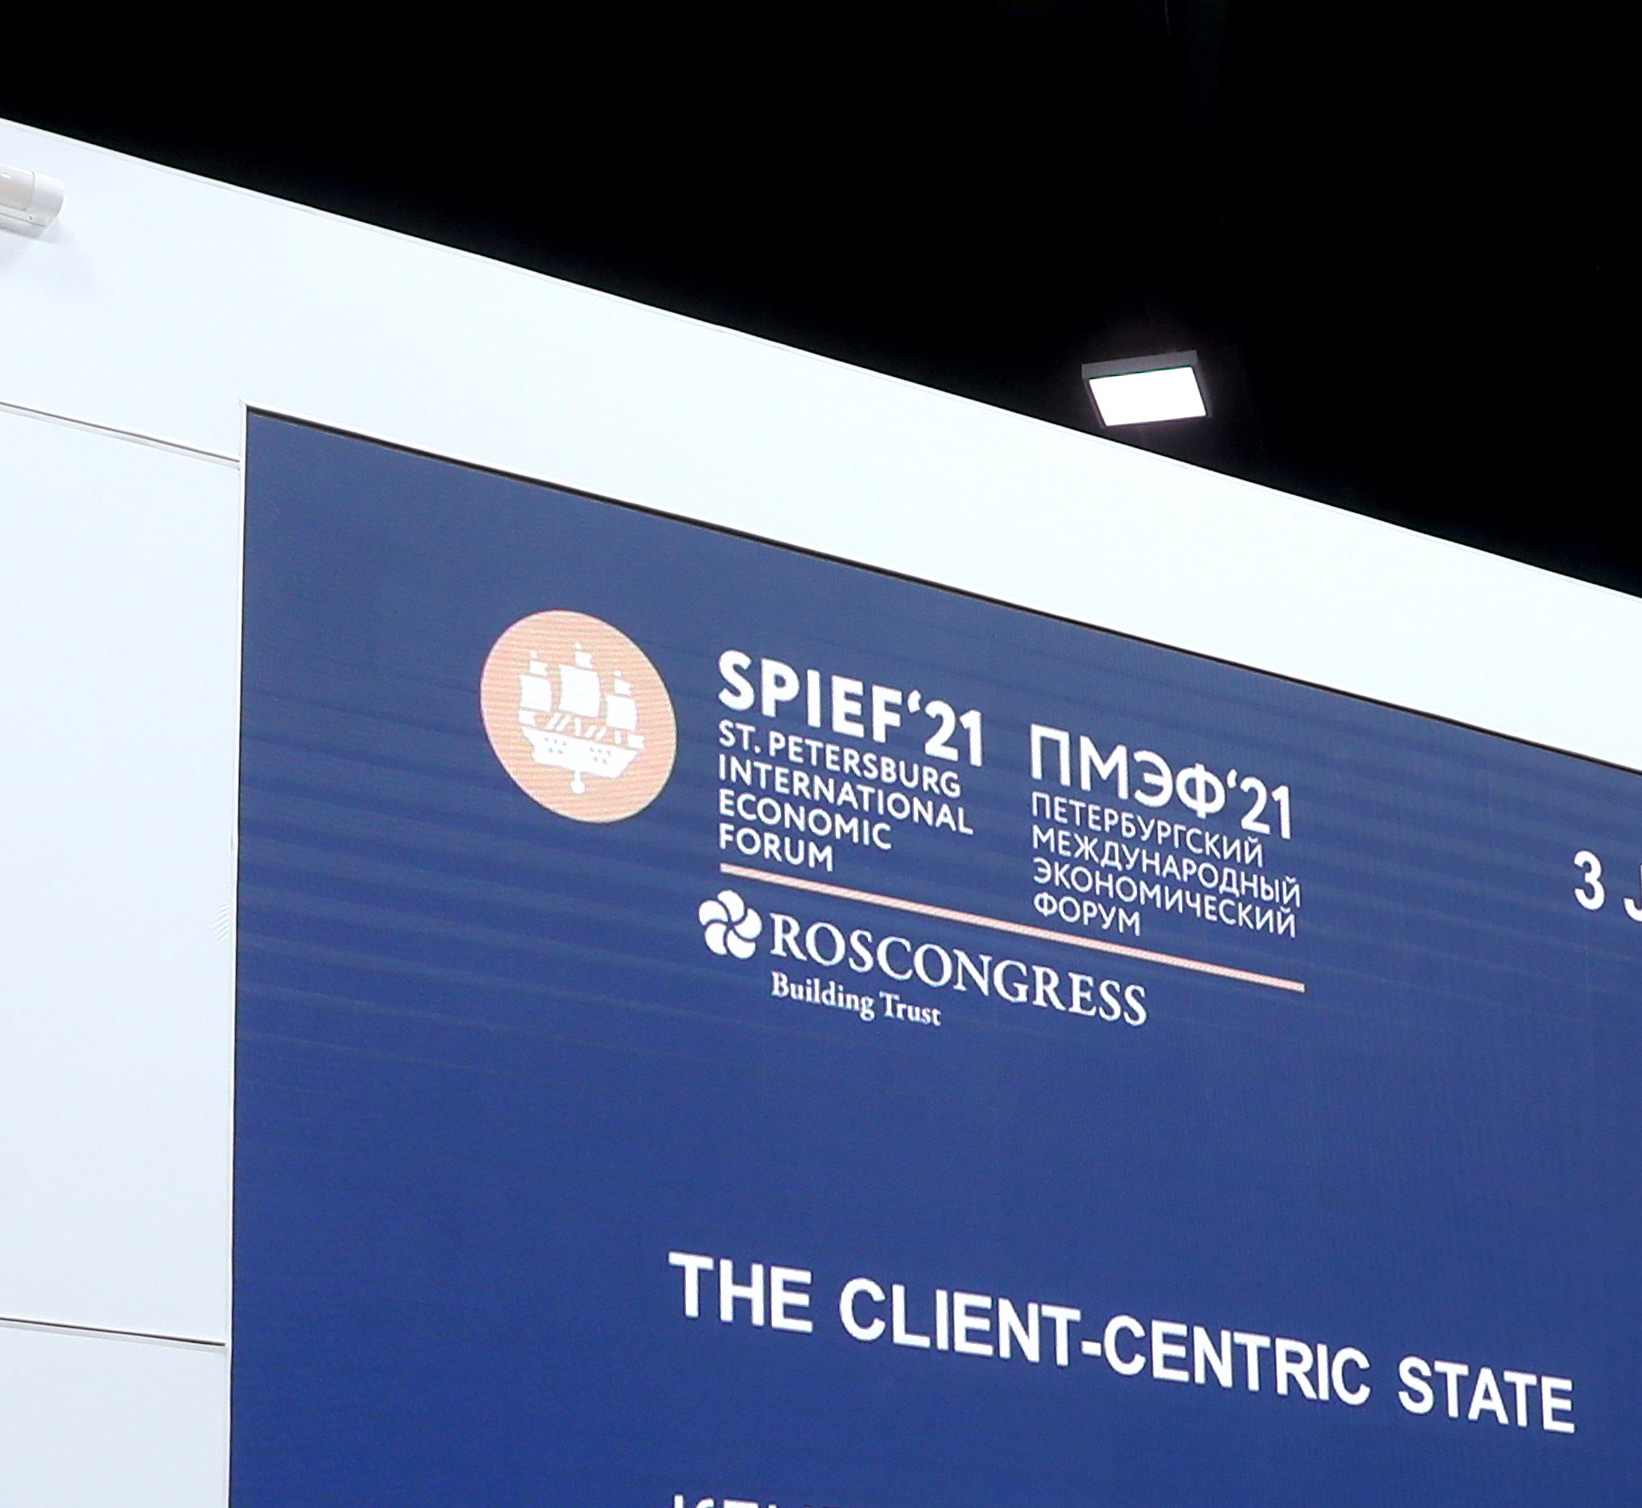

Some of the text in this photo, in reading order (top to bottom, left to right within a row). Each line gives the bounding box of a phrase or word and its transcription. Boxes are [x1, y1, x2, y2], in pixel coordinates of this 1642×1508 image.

[718, 719, 962, 799] ST. PETERSBURG
[718, 753, 974, 836] INTERNATIONAL
[718, 788, 893, 851] ECONOMIC
[718, 822, 834, 873] FORUM
[1031, 790, 1264, 868] ПЕТЕРБУРГСКИЙ
[1031, 824, 1302, 908] МЕЖДУНАРОДНЫЙ
[1032, 856, 1297, 939] ЭКОНОМИЧЕСКИЙ
[1572, 849, 1607, 912] 3
[1033, 891, 1141, 937] ФОРУМ
[768, 911, 1149, 1027] ROSCONGRESS
[770, 970, 943, 1027] Building Trust
[668, 1250, 1577, 1434] THE CLIENT-CENTRIC STATE
